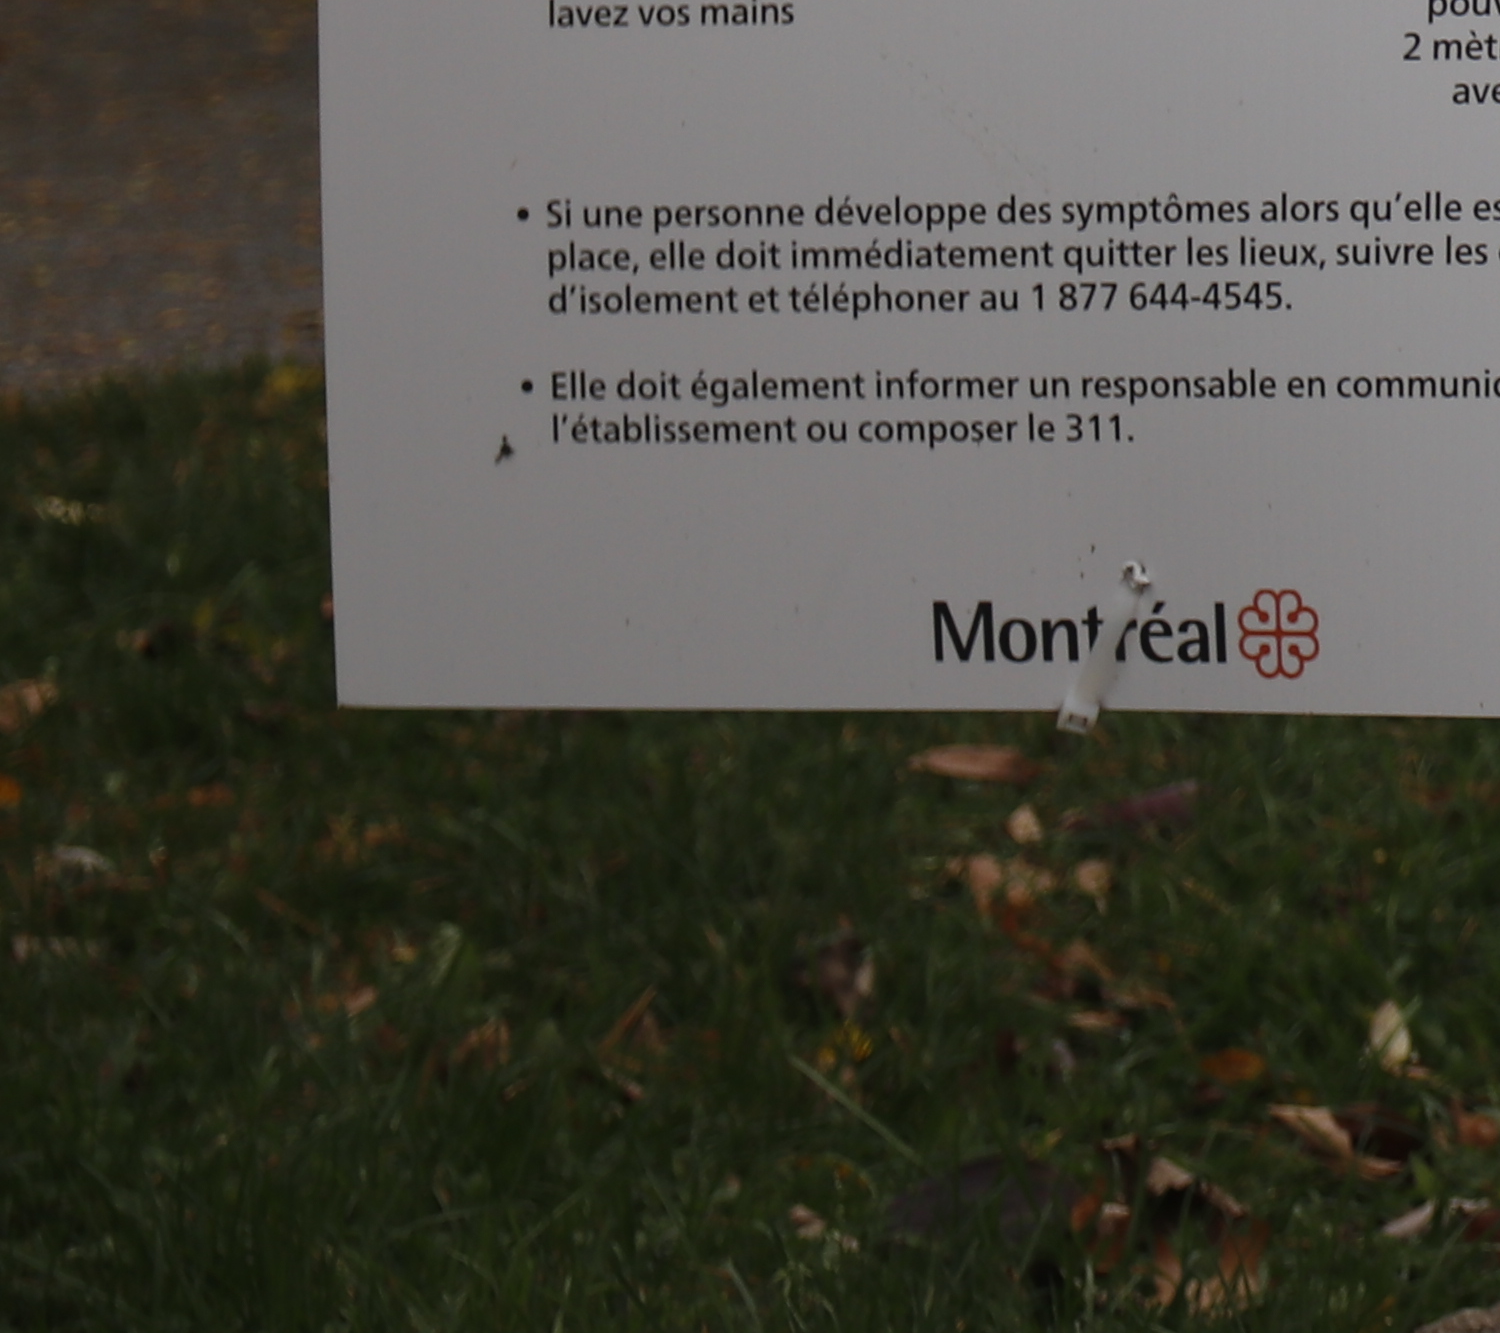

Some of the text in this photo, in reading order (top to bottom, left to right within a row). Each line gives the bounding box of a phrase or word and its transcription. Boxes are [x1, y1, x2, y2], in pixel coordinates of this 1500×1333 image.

[637, 4, 691, 27] vos
[1402, 31, 1422, 62] 2
[545, 198, 573, 229] Si
[582, 205, 644, 229] une
[652, 204, 806, 236] personne
[813, 194, 988, 234] développe
[996, 193, 1053, 225] des
[1061, 192, 1251, 233] symptômes
[1259, 191, 1340, 223] alors
